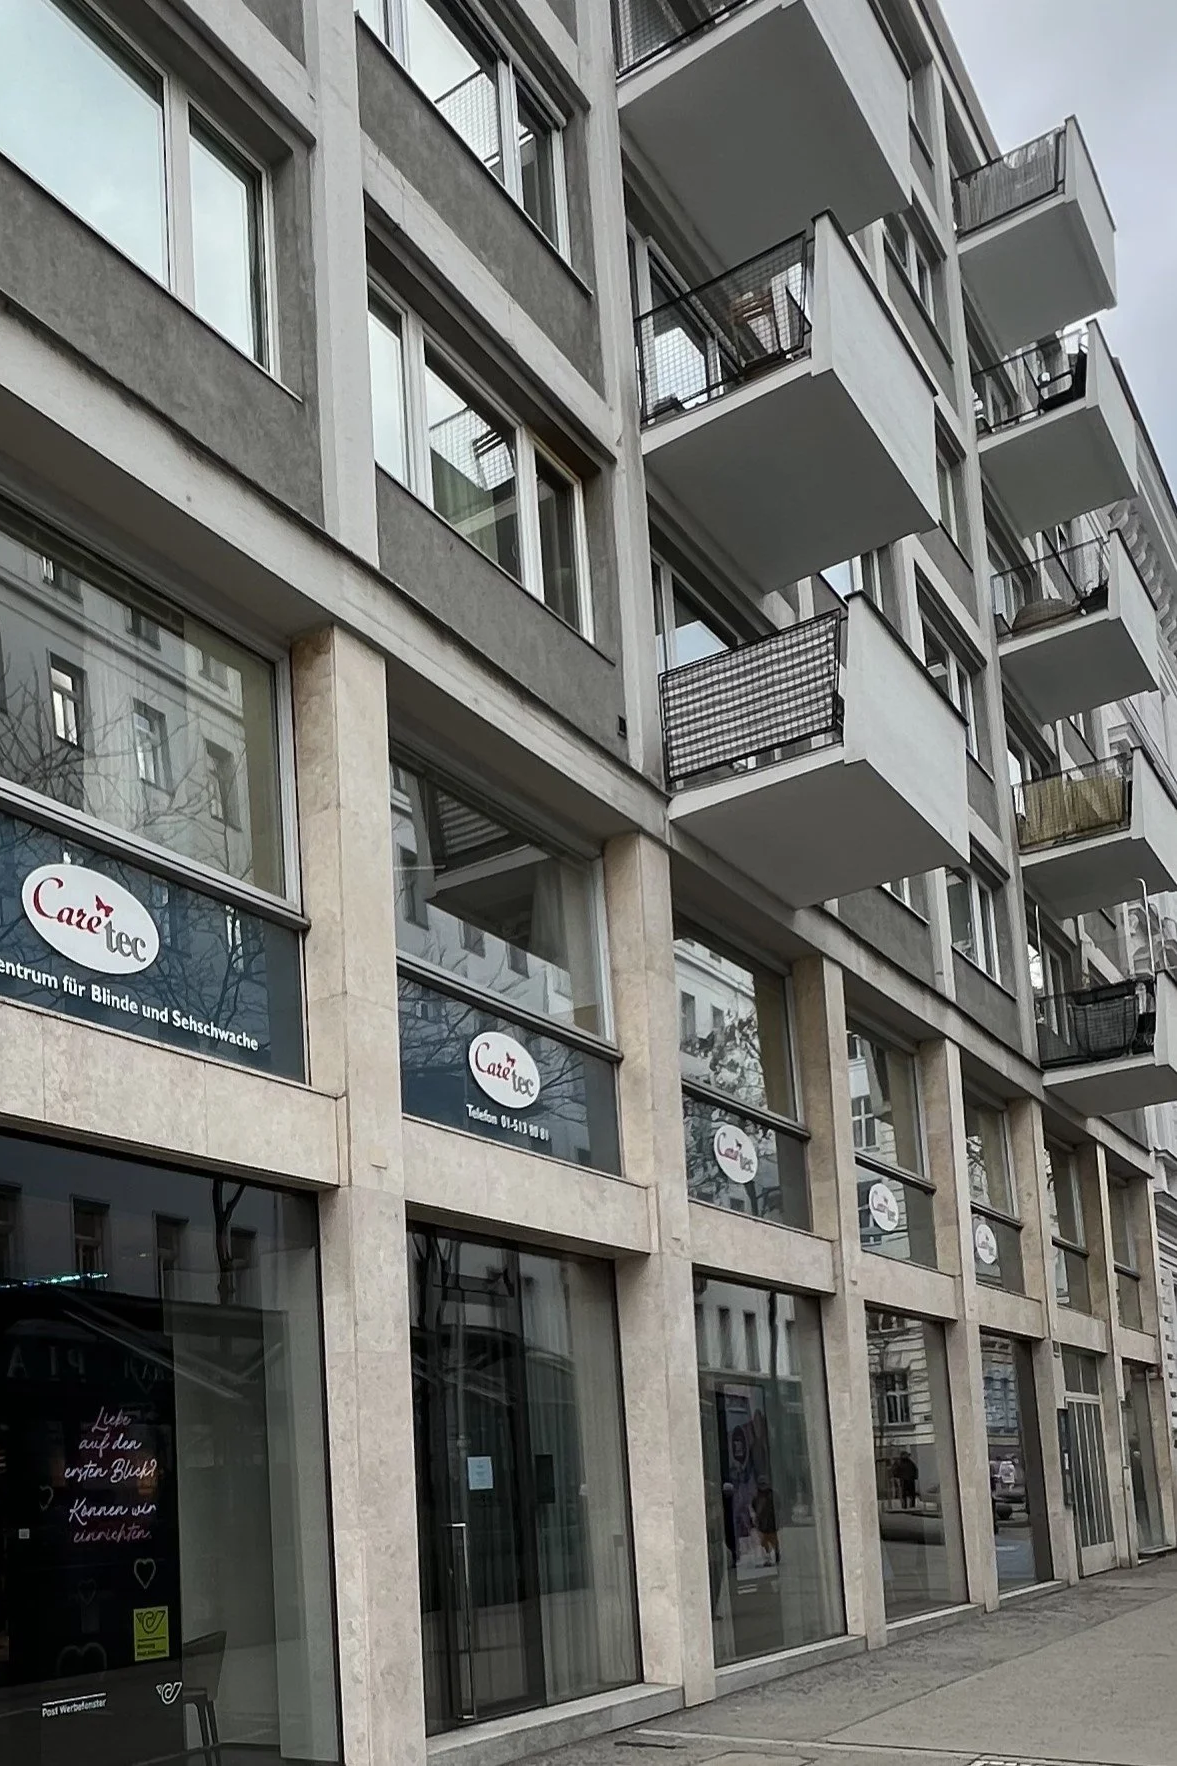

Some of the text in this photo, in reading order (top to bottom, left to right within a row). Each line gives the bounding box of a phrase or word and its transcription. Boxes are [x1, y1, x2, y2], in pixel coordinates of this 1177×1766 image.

[62, 975, 86, 998] für
[91, 984, 138, 1015] Blinde
[142, 1002, 169, 1024] und
[172, 1010, 258, 1051] Sehschwache
[466, 1103, 498, 1125] Telefon
[91, 1406, 131, 1432] Liebe
[78, 1433, 142, 1458] auf den
[64, 1457, 157, 1483] ersten Blick?
[131, 1502, 156, 1517] wir
[42, 1706, 58, 1717] Post
